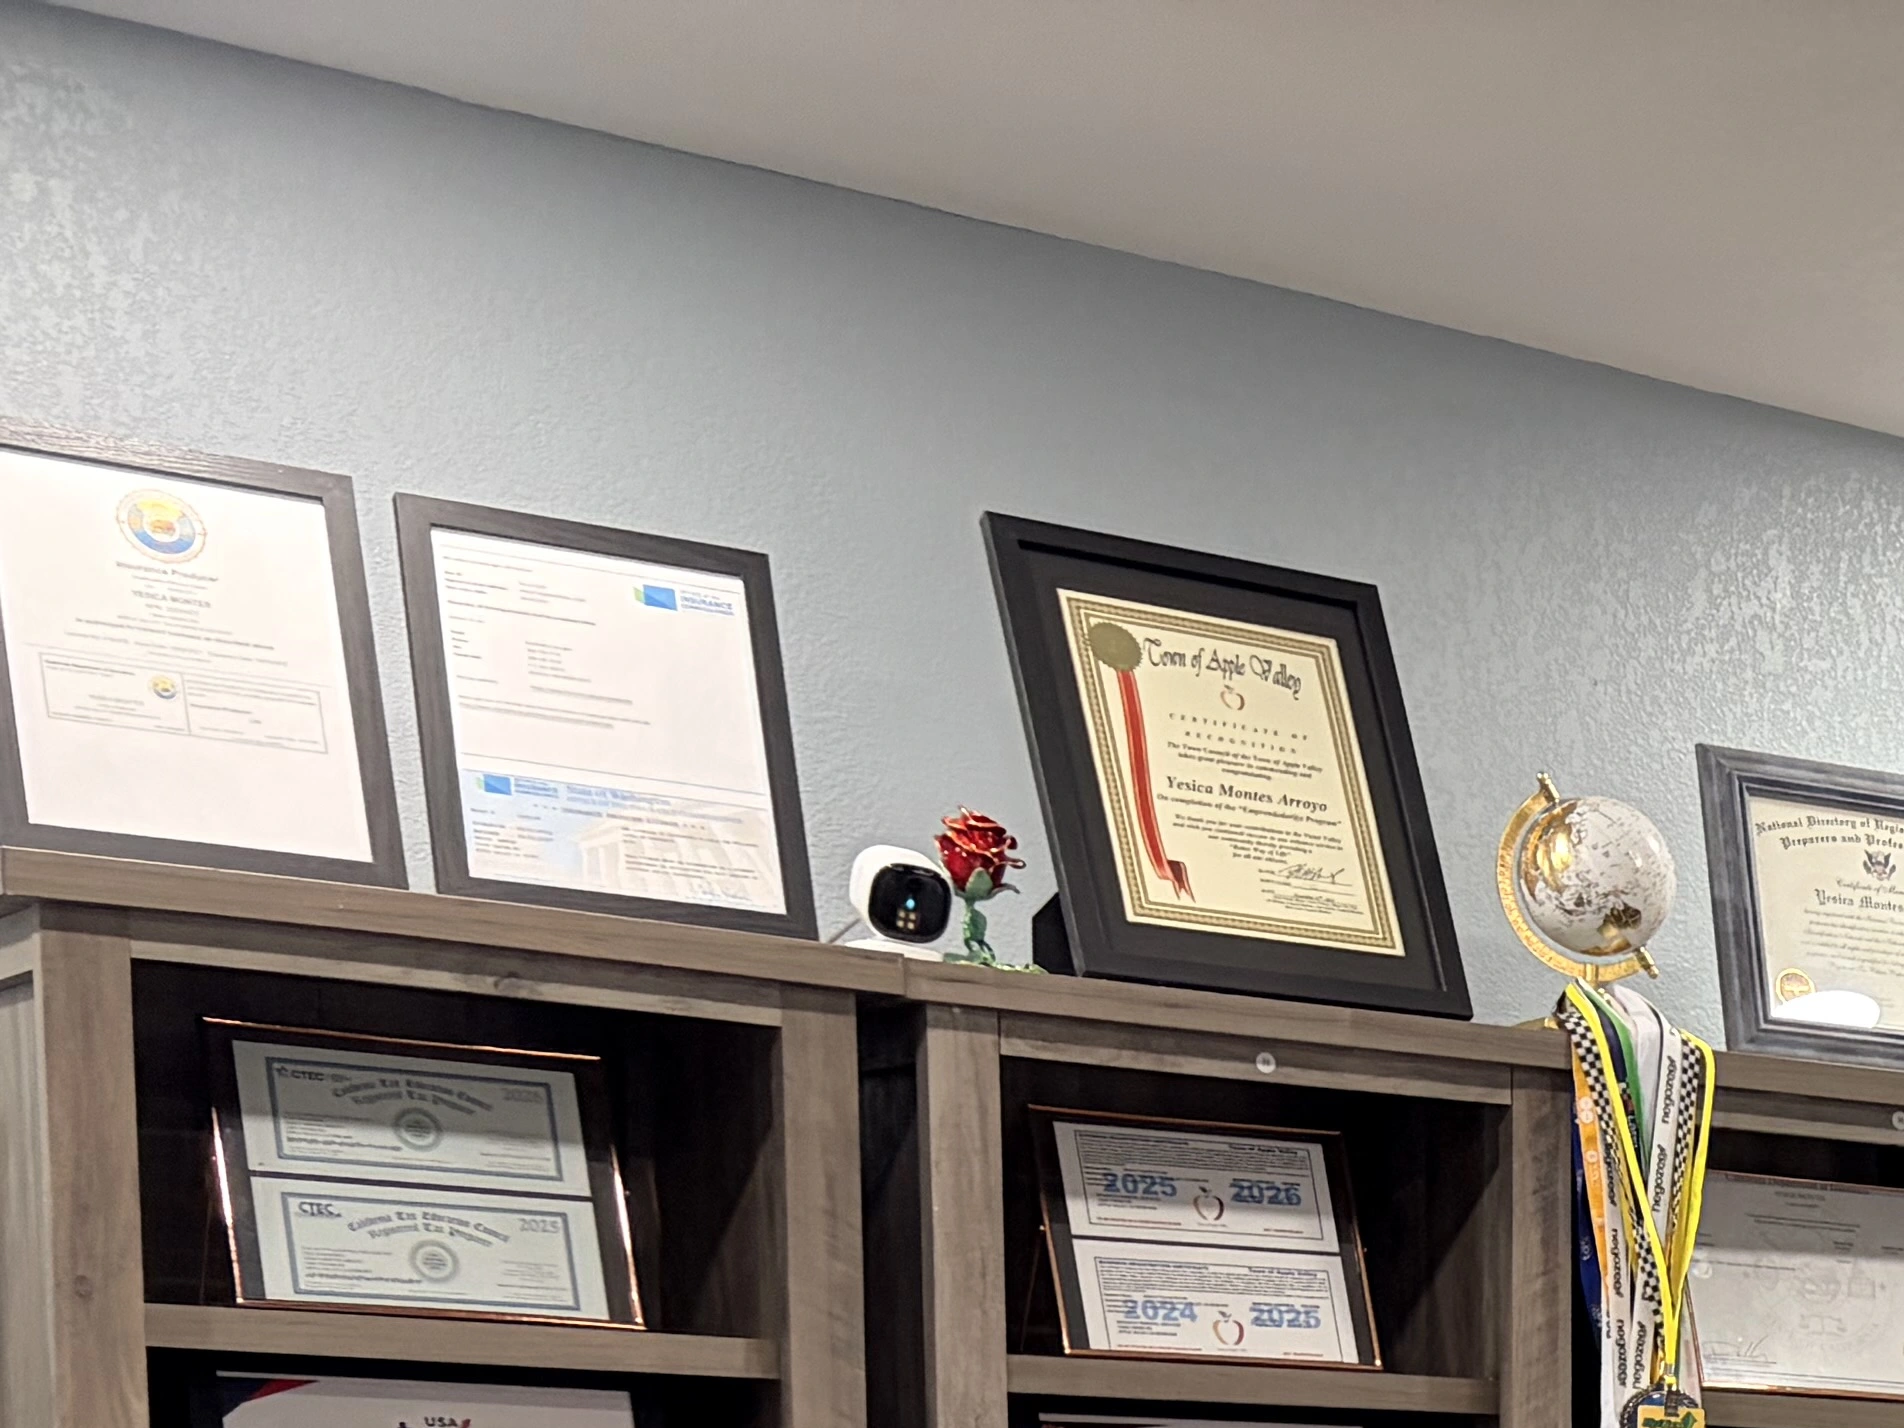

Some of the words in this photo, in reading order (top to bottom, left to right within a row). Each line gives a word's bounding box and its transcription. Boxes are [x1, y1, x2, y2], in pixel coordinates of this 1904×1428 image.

[1144, 638, 1186, 668] Town
[1191, 648, 1204, 676] of
[1206, 649, 1245, 681] Apple
[1249, 655, 1302, 699] Valley
[1167, 776, 1214, 794] Yesica
[1219, 783, 1273, 803] Montes
[1277, 794, 1327, 813] Arroyo
[1859, 897, 1904, 912] Montes
